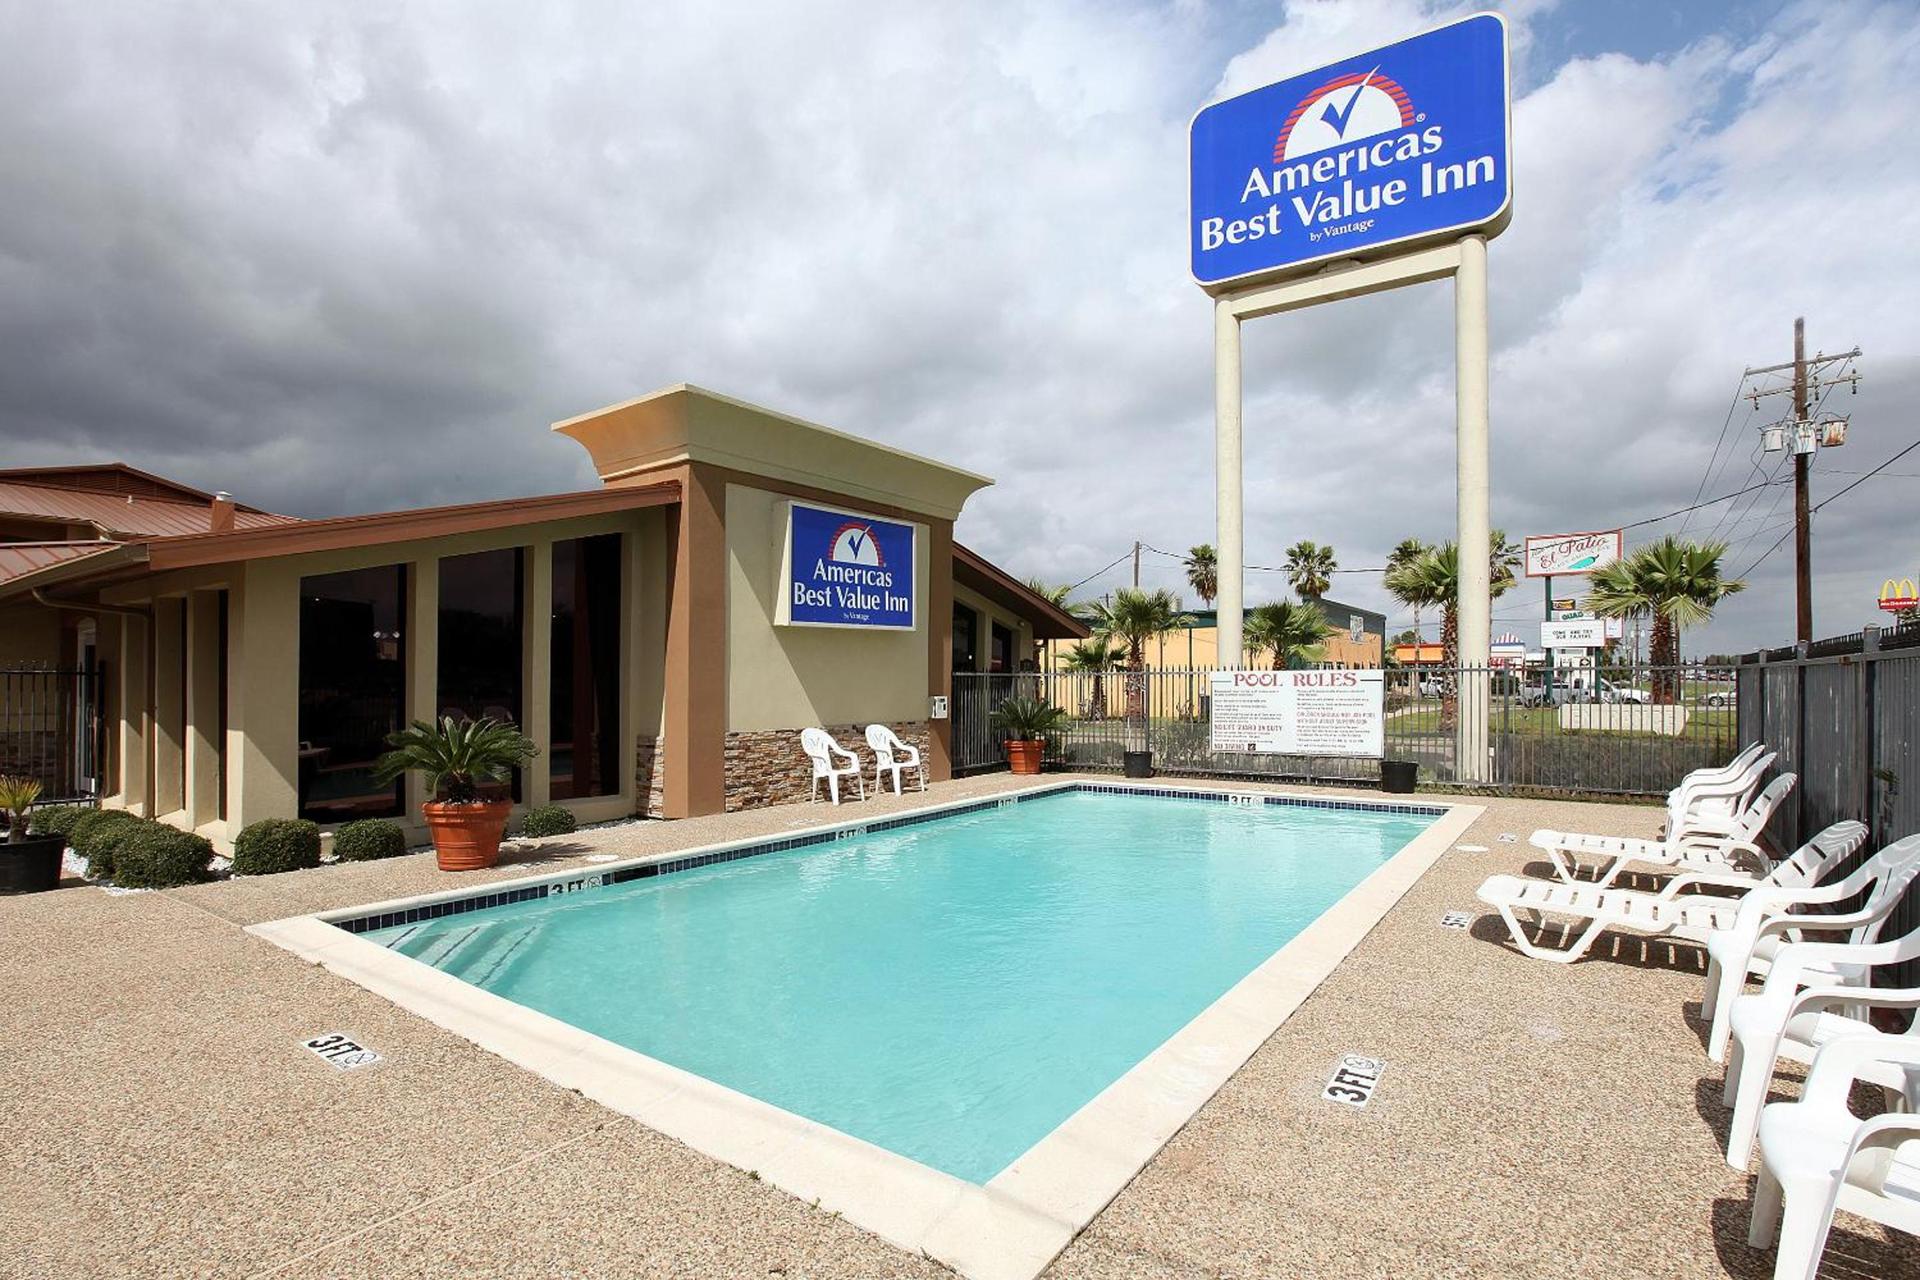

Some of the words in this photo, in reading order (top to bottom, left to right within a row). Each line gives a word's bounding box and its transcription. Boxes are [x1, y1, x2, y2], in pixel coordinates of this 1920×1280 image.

[1240, 125, 1443, 203] Americas
[1201, 203, 1282, 251] Best
[1291, 179, 1407, 227] Value
[1421, 155, 1495, 198] Inn
[1309, 231, 1323, 242] by
[1323, 218, 1375, 238] Vantage
[813, 558, 893, 588] Americas
[1540, 552, 1557, 568] El
[794, 582, 832, 608] Best
[836, 586, 880, 611] Value
[885, 590, 909, 612] Inn
[1234, 673, 1283, 687] POOL
[1293, 672, 1357, 687] RULES
